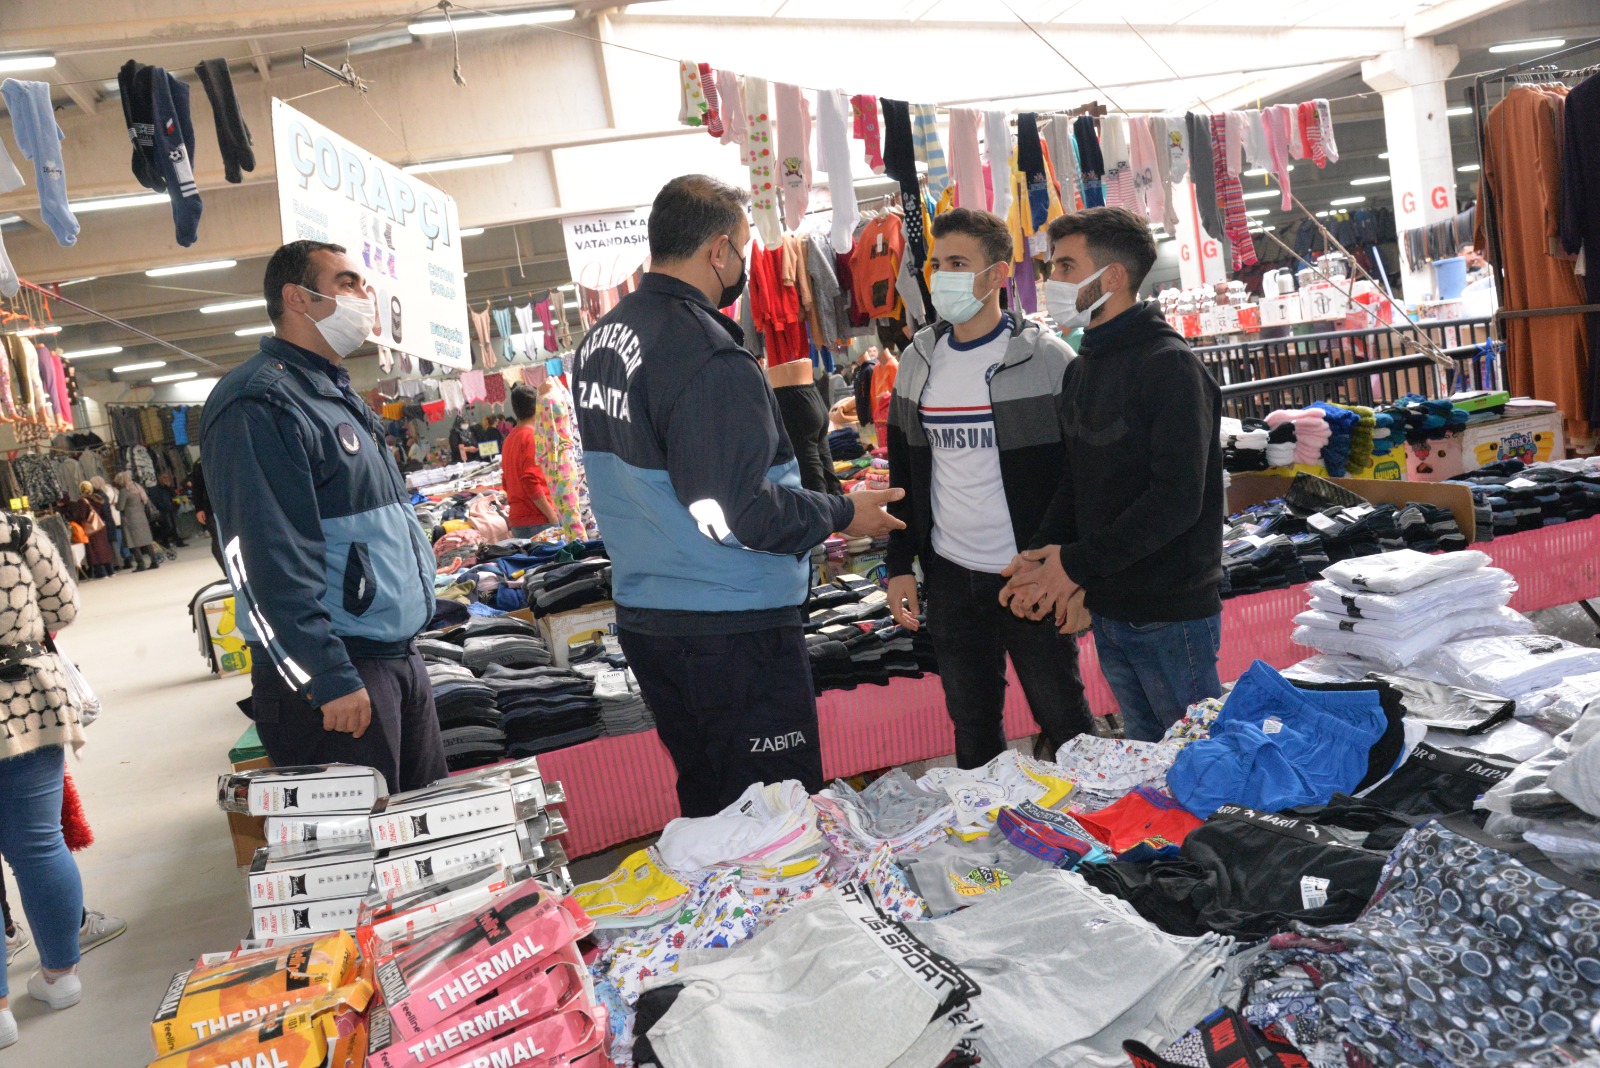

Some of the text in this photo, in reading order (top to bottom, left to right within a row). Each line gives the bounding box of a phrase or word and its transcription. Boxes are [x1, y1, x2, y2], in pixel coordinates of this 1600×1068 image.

[288, 120, 451, 251] ÇORAPÇI
[1402, 186, 1449, 214] G G
[574, 217, 649, 235] HALİL ALKA
[1180, 240, 1217, 262] G G
[580, 322, 643, 380] MENEMEN
[749, 730, 806, 752] ZABITA
[154, 968, 193, 1020] THERMAL
[378, 958, 411, 1005] THERMAL
[428, 935, 545, 1011] THERMAL
[368, 1007, 393, 1053] THERMAL
[400, 1001, 422, 1034] feelline
[408, 999, 530, 1064] THERMAL
